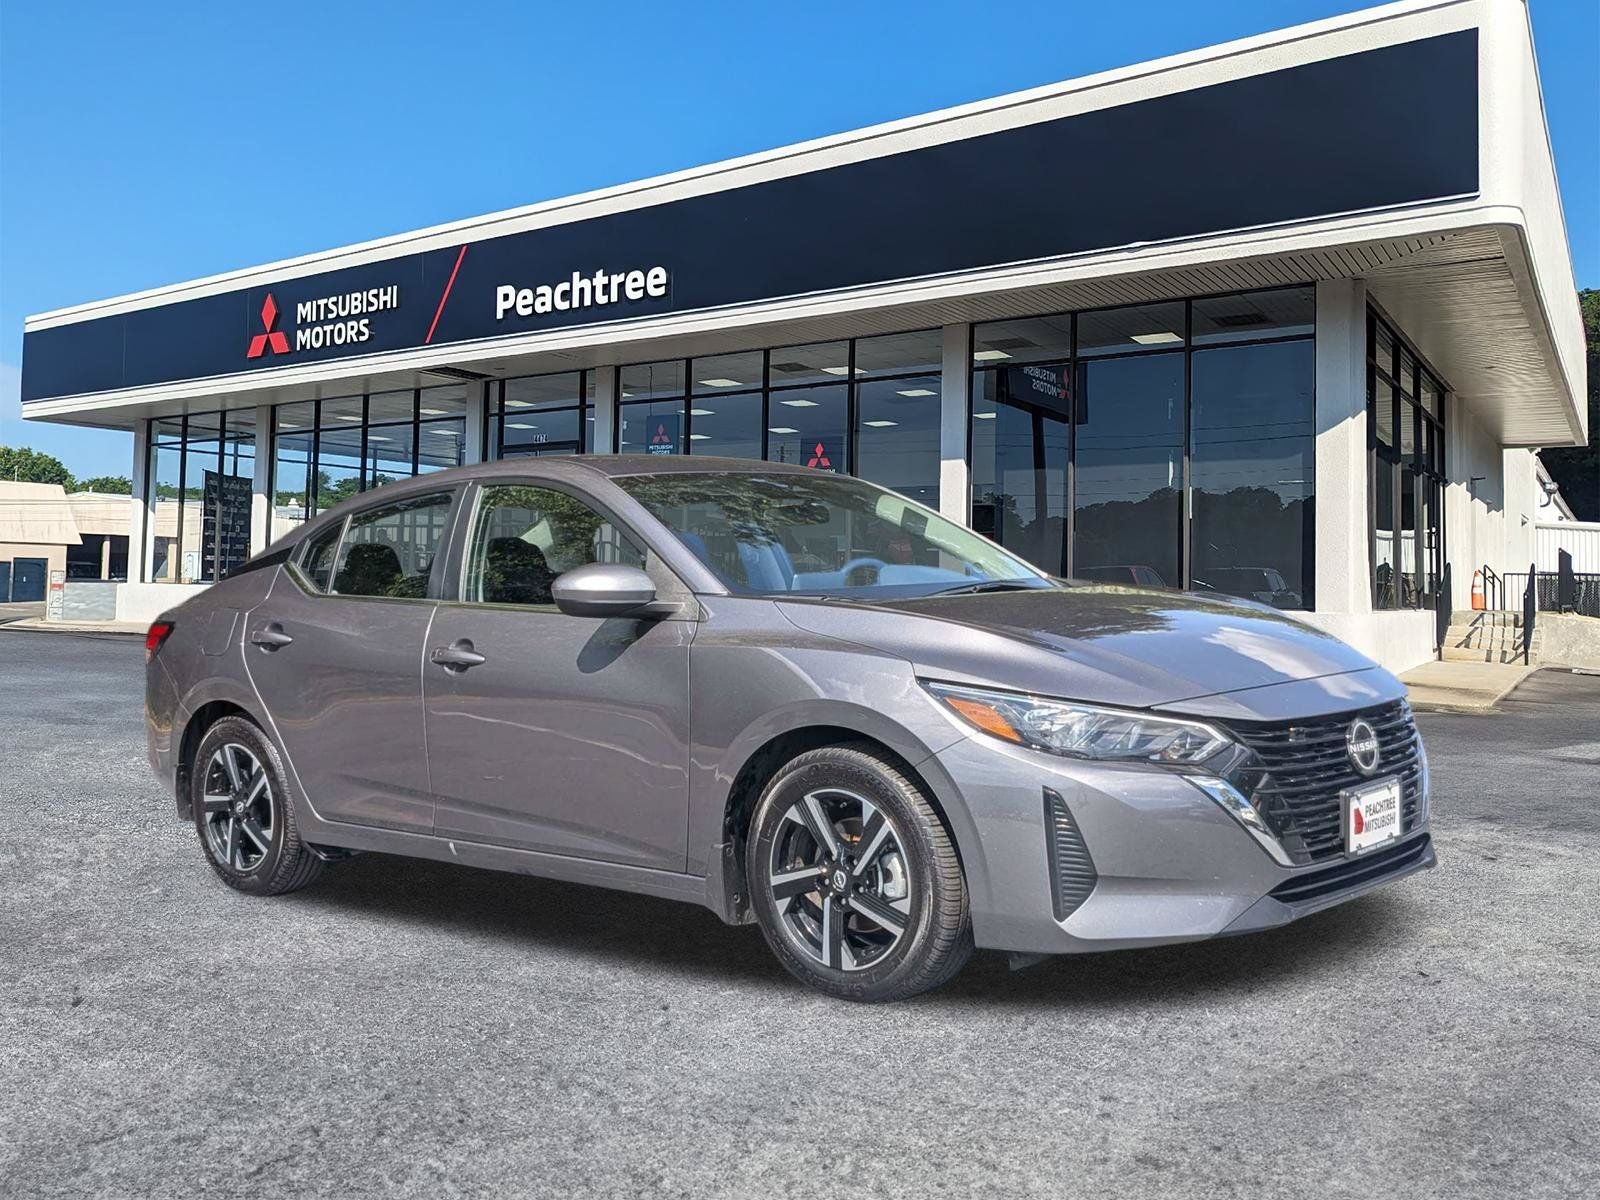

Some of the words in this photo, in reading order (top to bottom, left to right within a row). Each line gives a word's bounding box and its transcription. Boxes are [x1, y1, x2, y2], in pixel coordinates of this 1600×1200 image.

[296, 285, 398, 323] MITSUBISHI
[496, 266, 667, 319] Peachtree
[296, 318, 371, 351] MOTORS
[1364, 811, 1396, 833] MITSUBISHI
[1365, 796, 1396, 819] PEACHTREE
